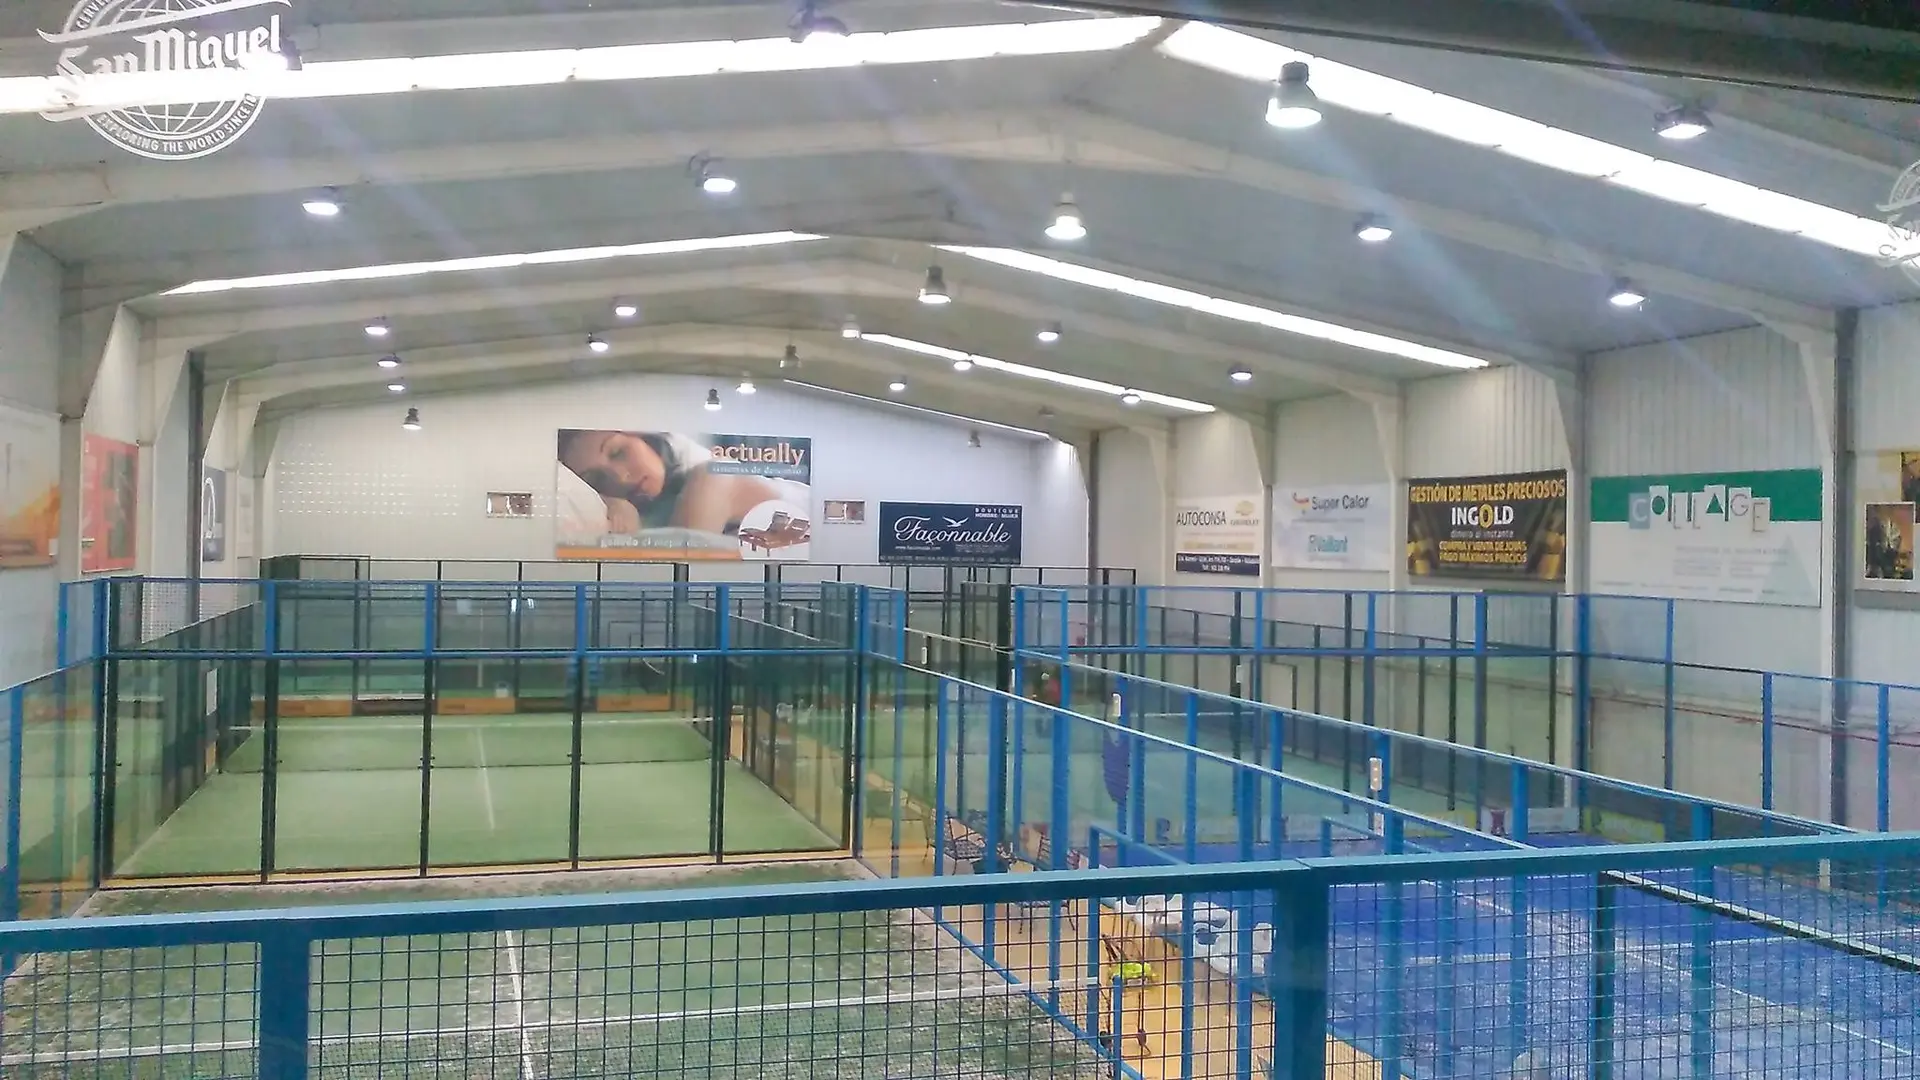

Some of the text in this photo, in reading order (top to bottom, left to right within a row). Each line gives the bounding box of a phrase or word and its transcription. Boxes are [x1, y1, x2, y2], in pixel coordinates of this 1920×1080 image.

[132, 14, 281, 73] Miguel
[96, 114, 160, 152] EXPLORING
[163, 141, 184, 153] THE
[187, 128, 226, 151] WORLD
[223, 105, 251, 133] SINCE
[710, 442, 805, 468] actually
[1342, 494, 1369, 510] Calor
[1410, 478, 1566, 502] GESTIÓN DE METALES PRECIOSOS
[1176, 510, 1227, 526] AUTOCONSA
[1451, 503, 1515, 529] INGOLD
[1631, 491, 1767, 533] COLLAGE
[894, 515, 1012, 545] Façonnable
